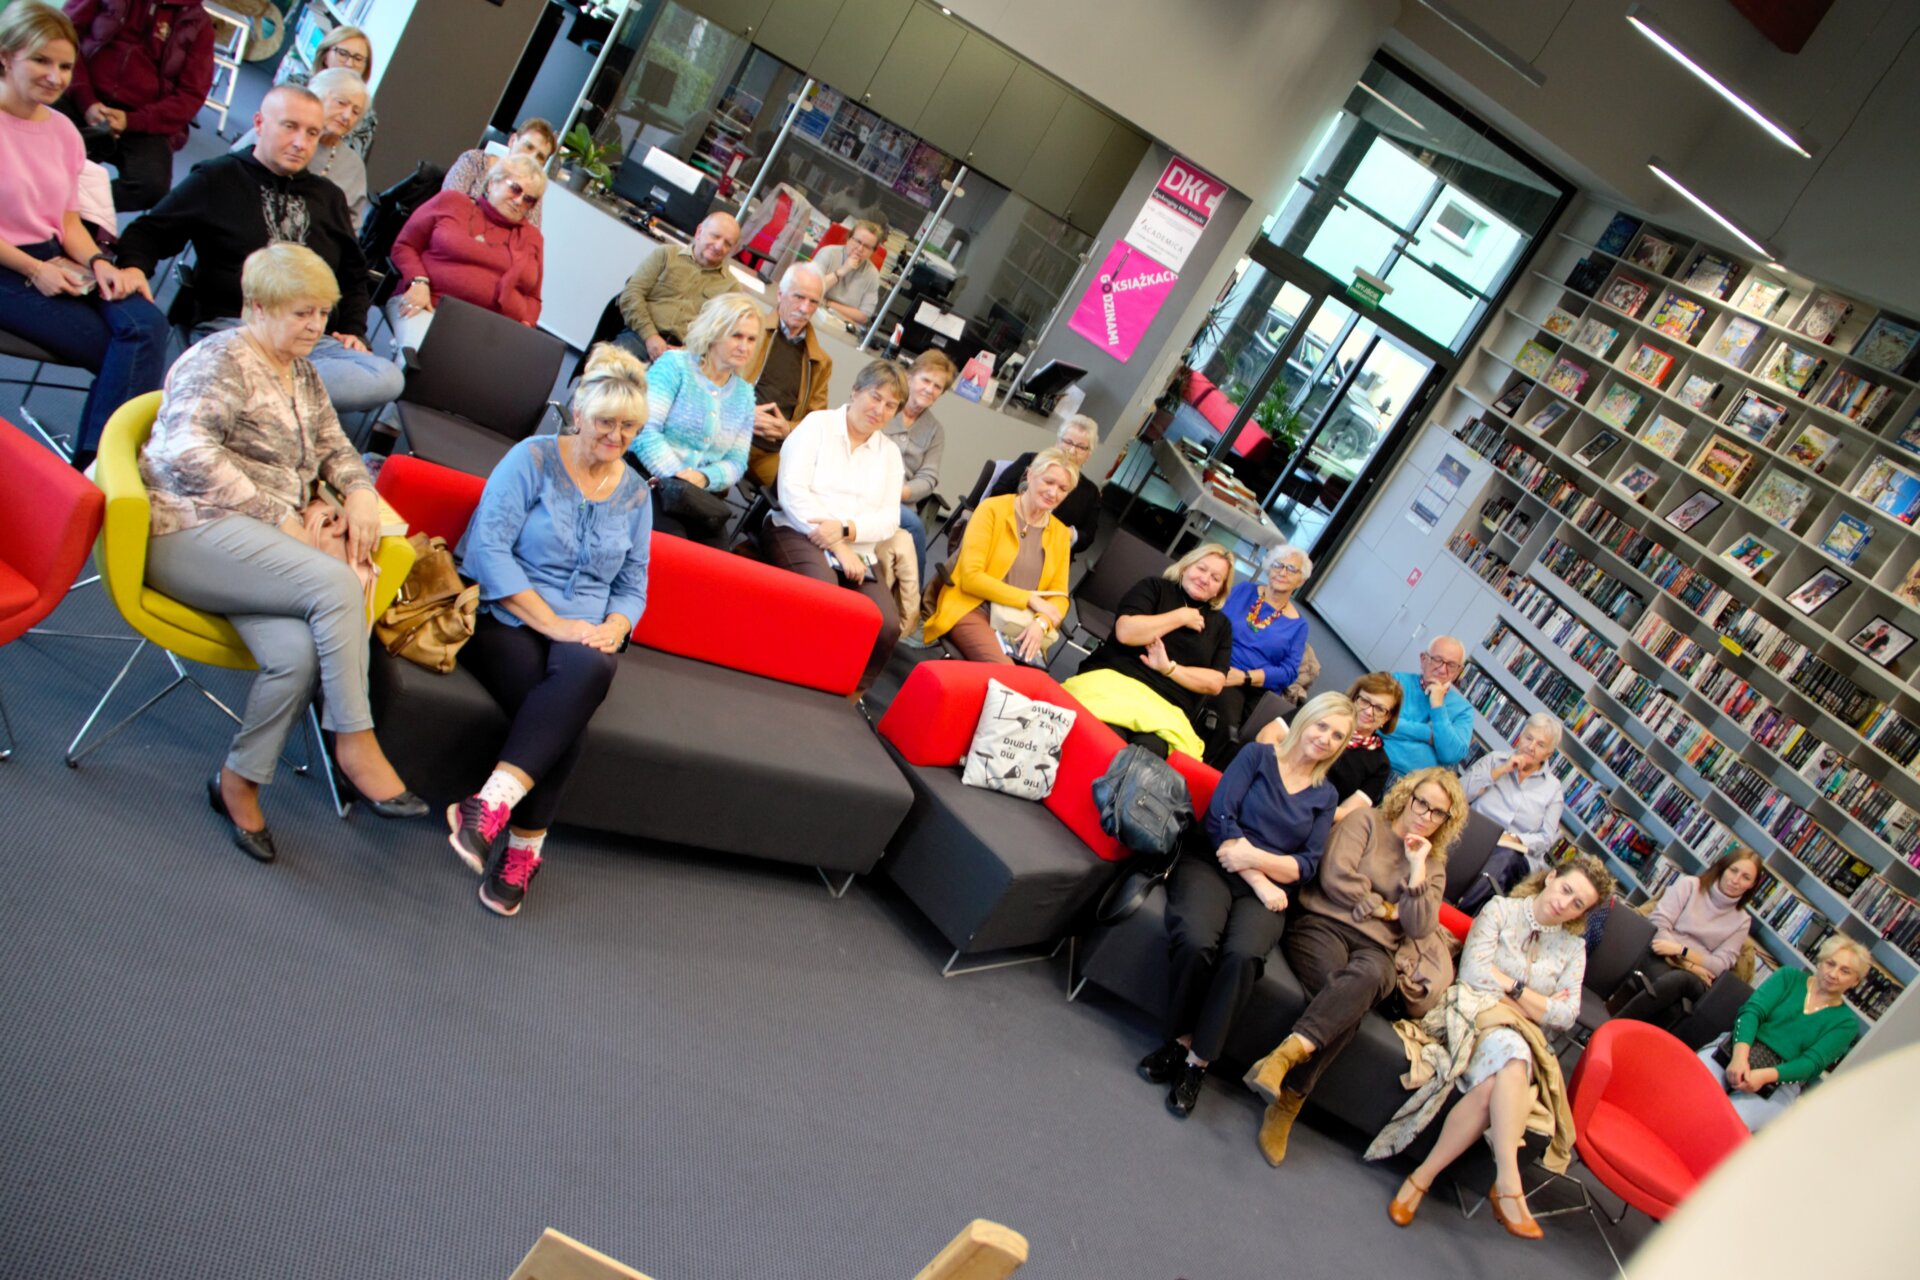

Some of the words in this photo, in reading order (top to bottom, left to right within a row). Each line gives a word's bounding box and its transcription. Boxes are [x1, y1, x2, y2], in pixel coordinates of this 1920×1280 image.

[1141, 224, 1184, 253] ACADEMICA
[1003, 737, 1038, 752] spania
[1023, 778, 1040, 791] nie
